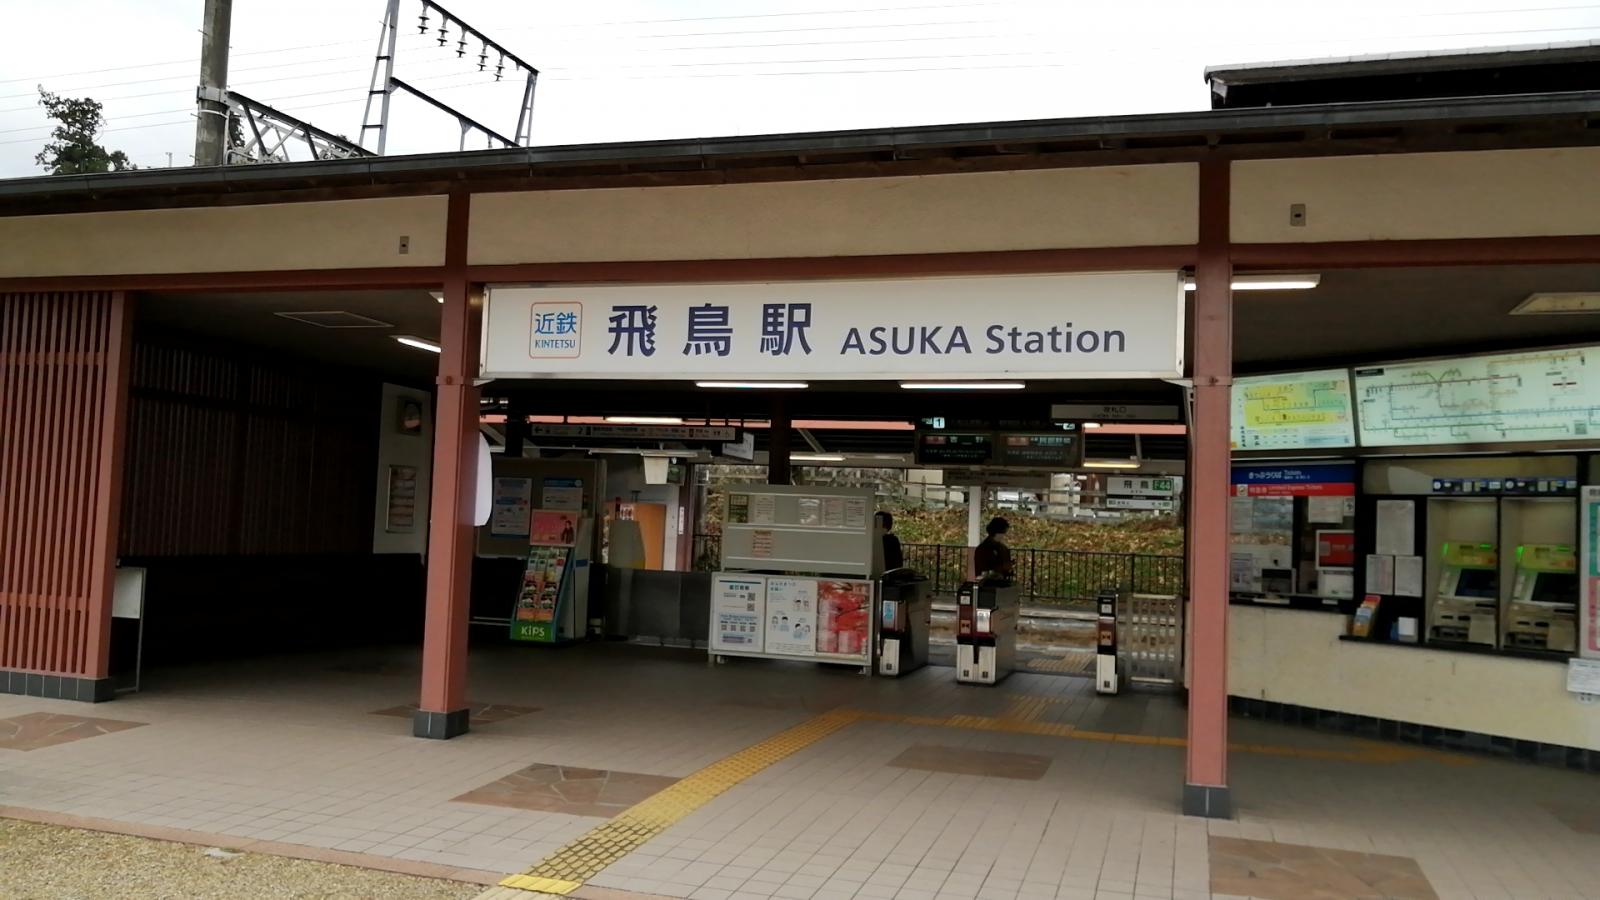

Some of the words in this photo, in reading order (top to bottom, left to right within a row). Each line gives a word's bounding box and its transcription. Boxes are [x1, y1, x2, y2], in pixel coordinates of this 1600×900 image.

[535, 312, 577, 335] 近鉄
[607, 302, 812, 357] 飛鳥駅
[535, 339, 576, 349] KINTETSU
[840, 325, 972, 355] ASUKA
[985, 322, 1126, 354] Station
